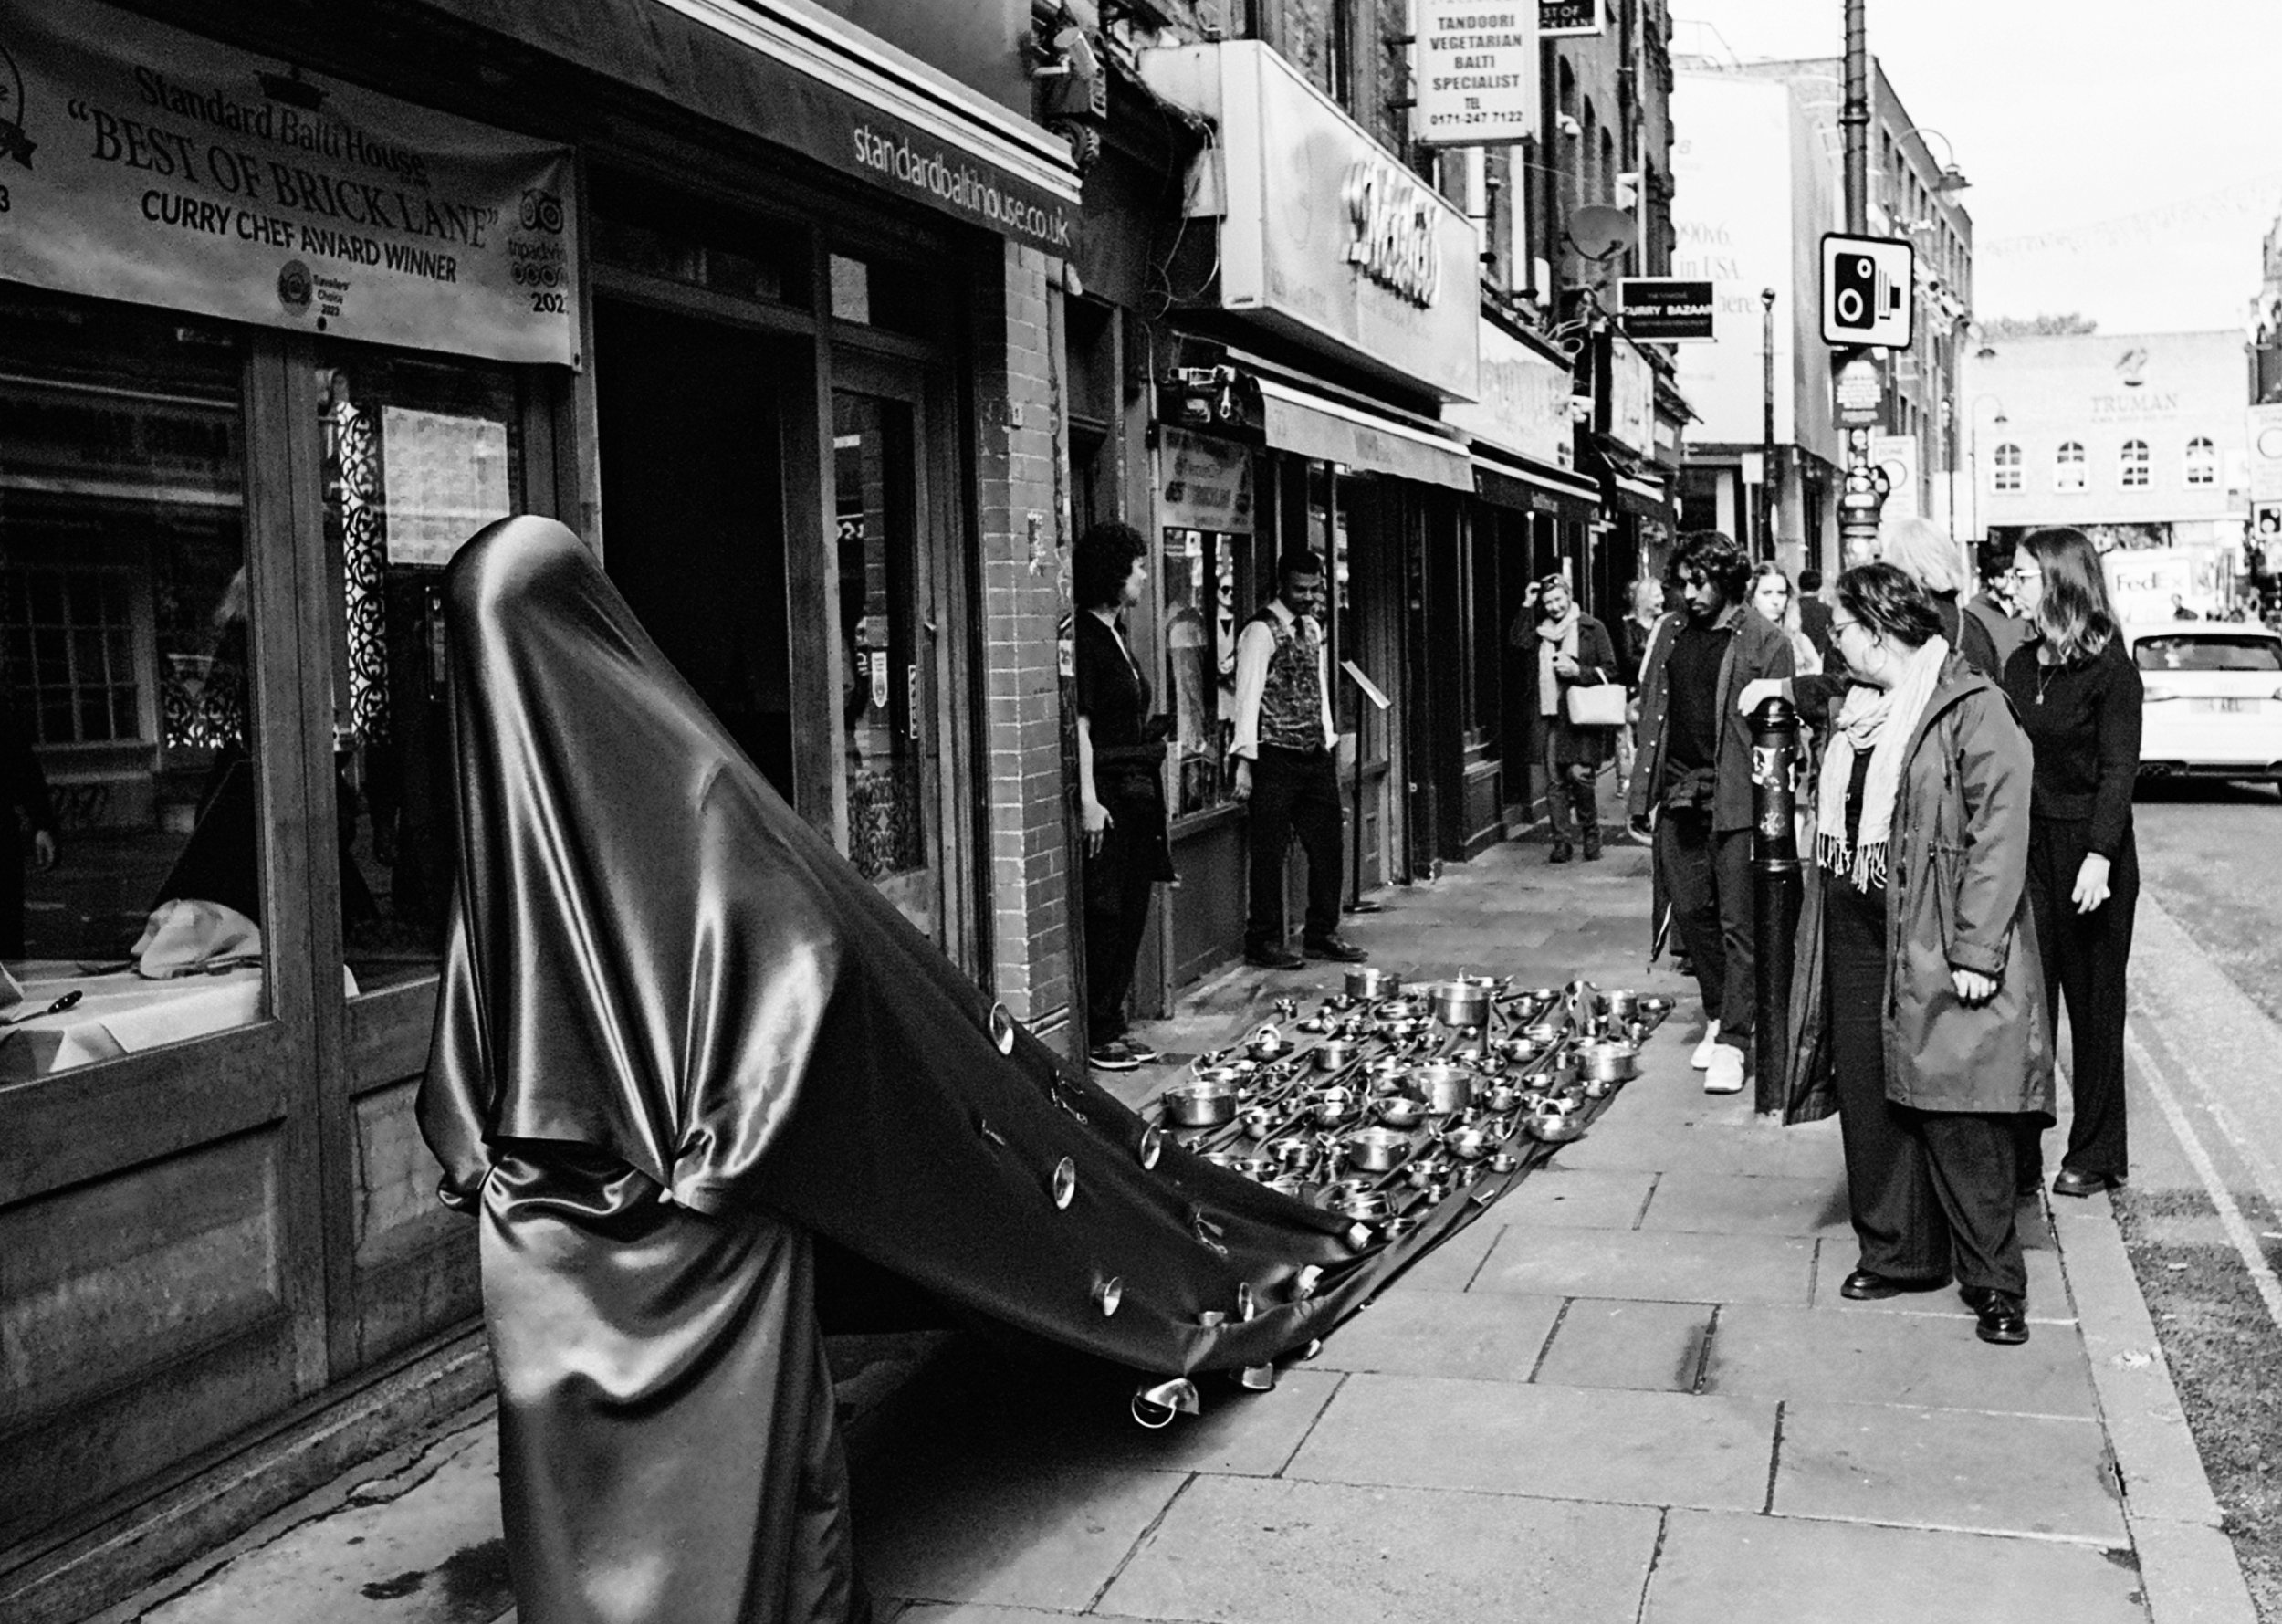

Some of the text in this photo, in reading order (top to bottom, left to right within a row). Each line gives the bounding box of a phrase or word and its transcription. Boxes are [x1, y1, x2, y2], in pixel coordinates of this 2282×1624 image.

[1438, 15, 1515, 31] TANDOORI
[1430, 34, 1523, 50] VEGETARIAN
[1454, 55, 1495, 69] BALTI
[1433, 74, 1521, 91] SPECIALIST
[1464, 97, 1481, 110] TEL
[134, 65, 426, 176] Standard Balti House
[1429, 111, 1523, 126] 0171-247 7122
[207, 145, 262, 198] OF
[268, 161, 397, 230] BRICK
[854, 125, 1071, 248] standardbaltihouse.co.uk
[141, 190, 457, 284] CURRY CHEF AWARD WINNER
[531, 292, 570, 313] 202
[1623, 304, 1662, 316] CURRY
[2089, 393, 2179, 413] TRUMAN
[2117, 571, 2183, 591] FedEx
